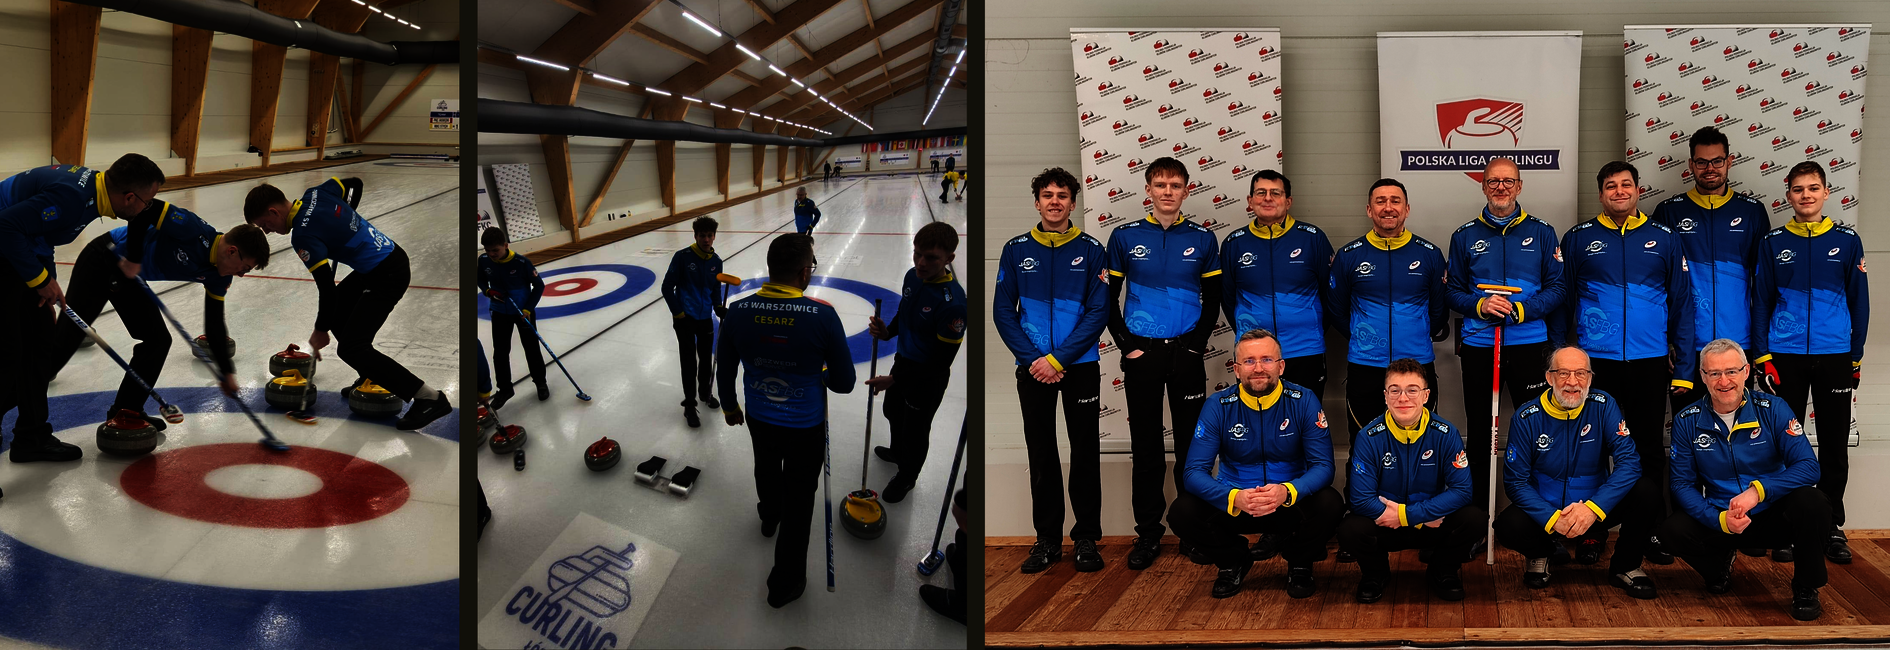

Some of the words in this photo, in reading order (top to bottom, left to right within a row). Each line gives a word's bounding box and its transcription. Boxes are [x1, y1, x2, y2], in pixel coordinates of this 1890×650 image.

[1407, 155, 1456, 166] POLSKA
[1459, 155, 1487, 166] LIGA
[750, 301, 819, 314] WARSZOWICE
[754, 315, 795, 326] CESARZ
[749, 380, 804, 398] JASFBG
